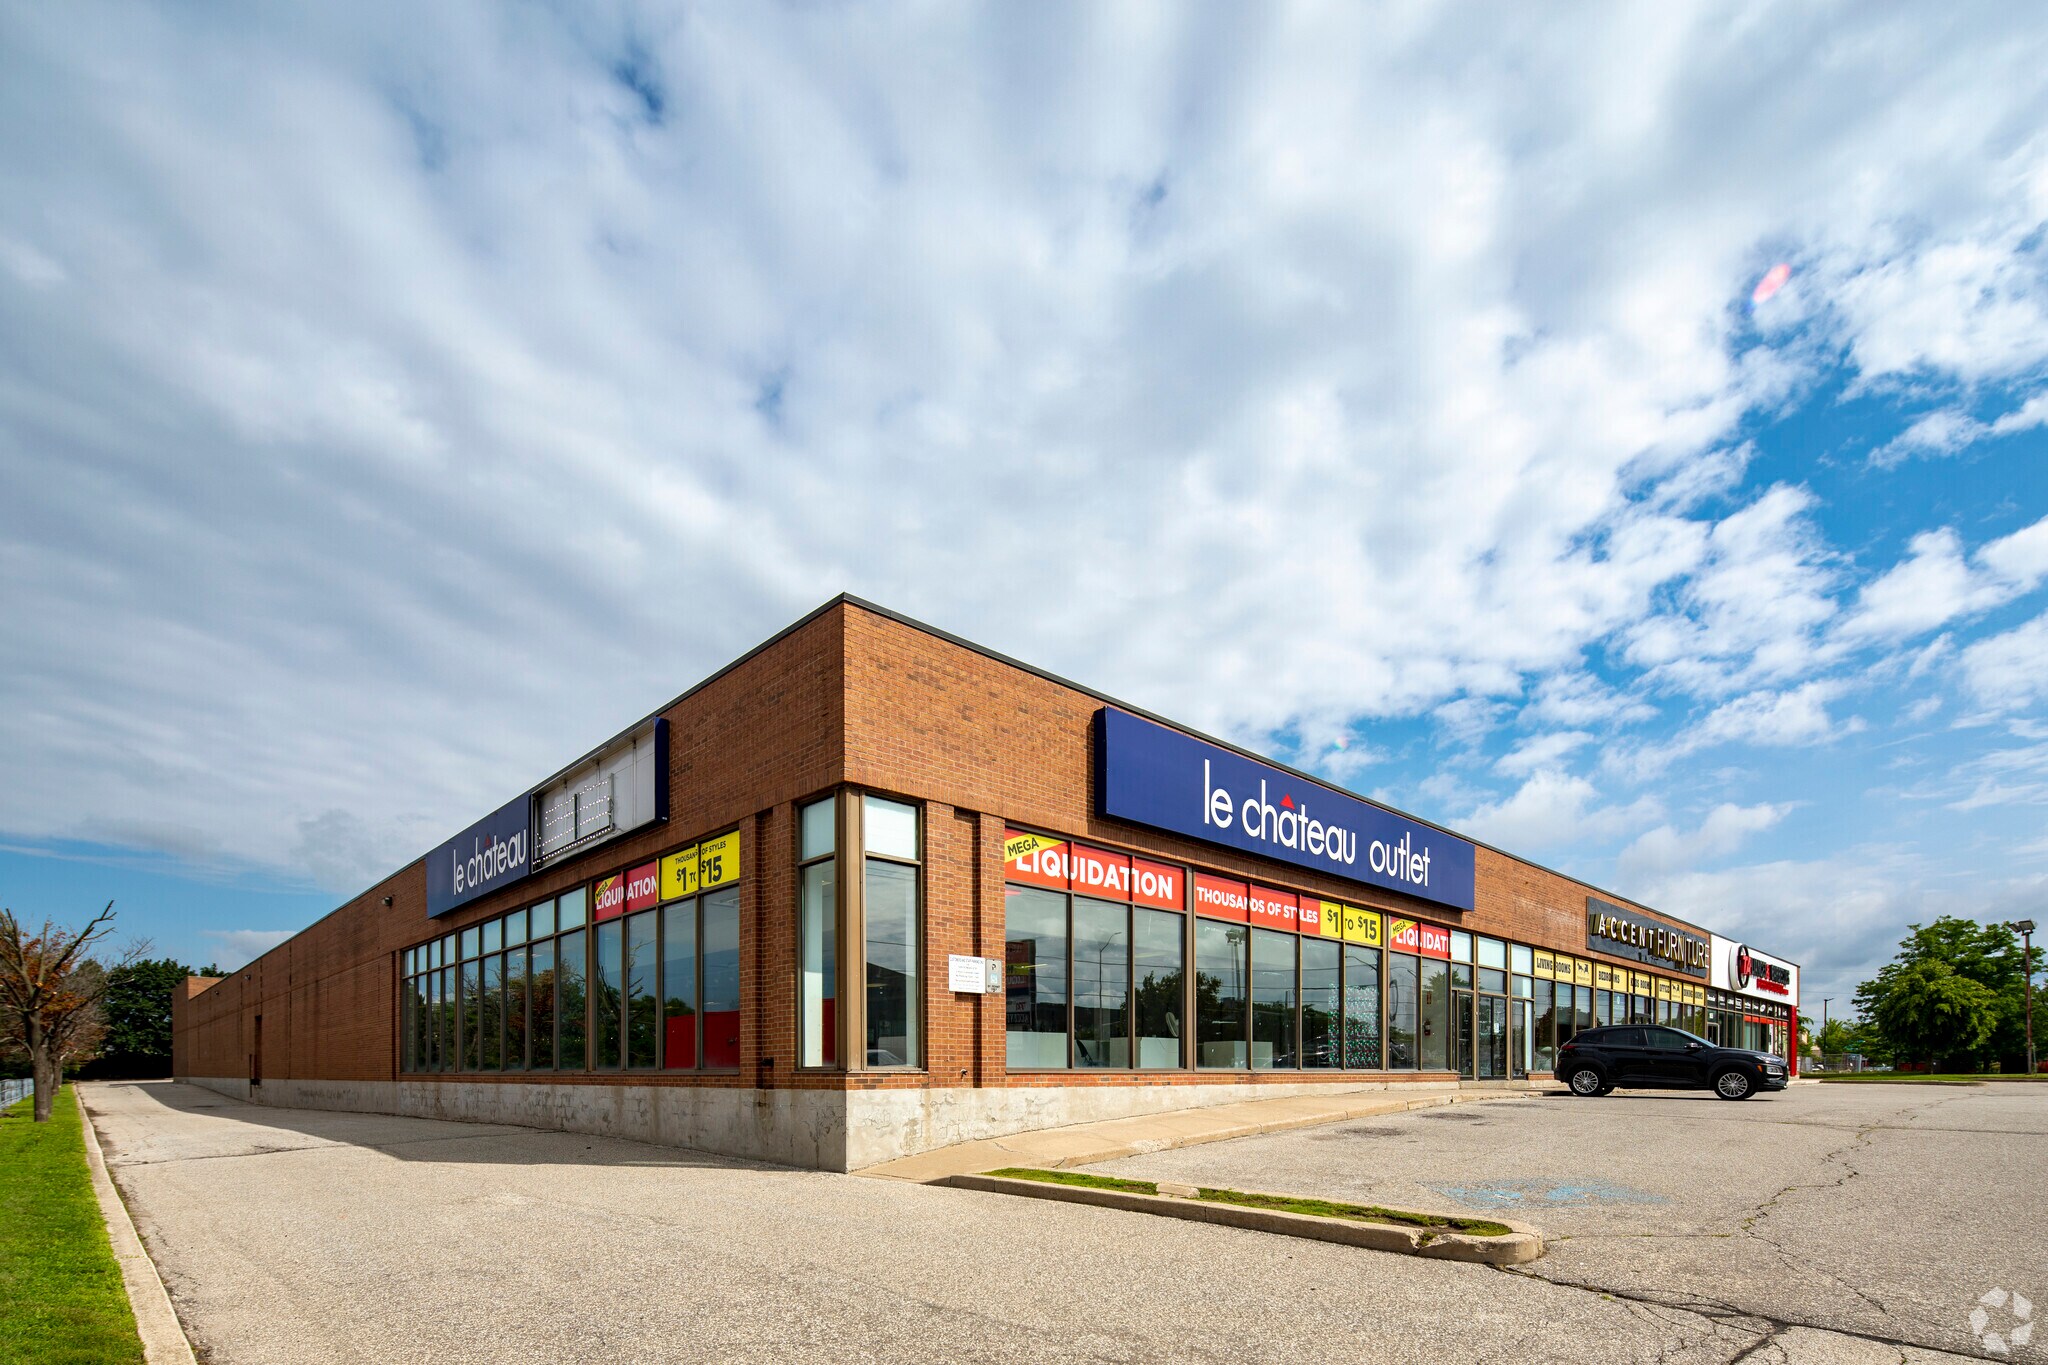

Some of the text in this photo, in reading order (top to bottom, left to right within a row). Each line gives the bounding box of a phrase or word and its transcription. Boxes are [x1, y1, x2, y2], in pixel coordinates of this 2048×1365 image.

[1204, 759, 1233, 829] le
[1369, 831, 1431, 887] outlet
[701, 847, 709, 855] OF
[709, 840, 727, 853] STYLES
[1007, 837, 1040, 857] MEGA
[453, 849, 464, 896] le
[676, 866, 687, 892] $1
[701, 855, 723, 883] $15
[1016, 849, 1173, 900] LIQUIDATION
[1267, 901, 1282, 917] OF
[1327, 908, 1339, 933] $1
[1357, 915, 1377, 941] $15
[1392, 921, 1407, 934] MEGA
[1597, 913, 1710, 969] ACCENT FURNITURE
[1536, 957, 1553, 971] LIVING
